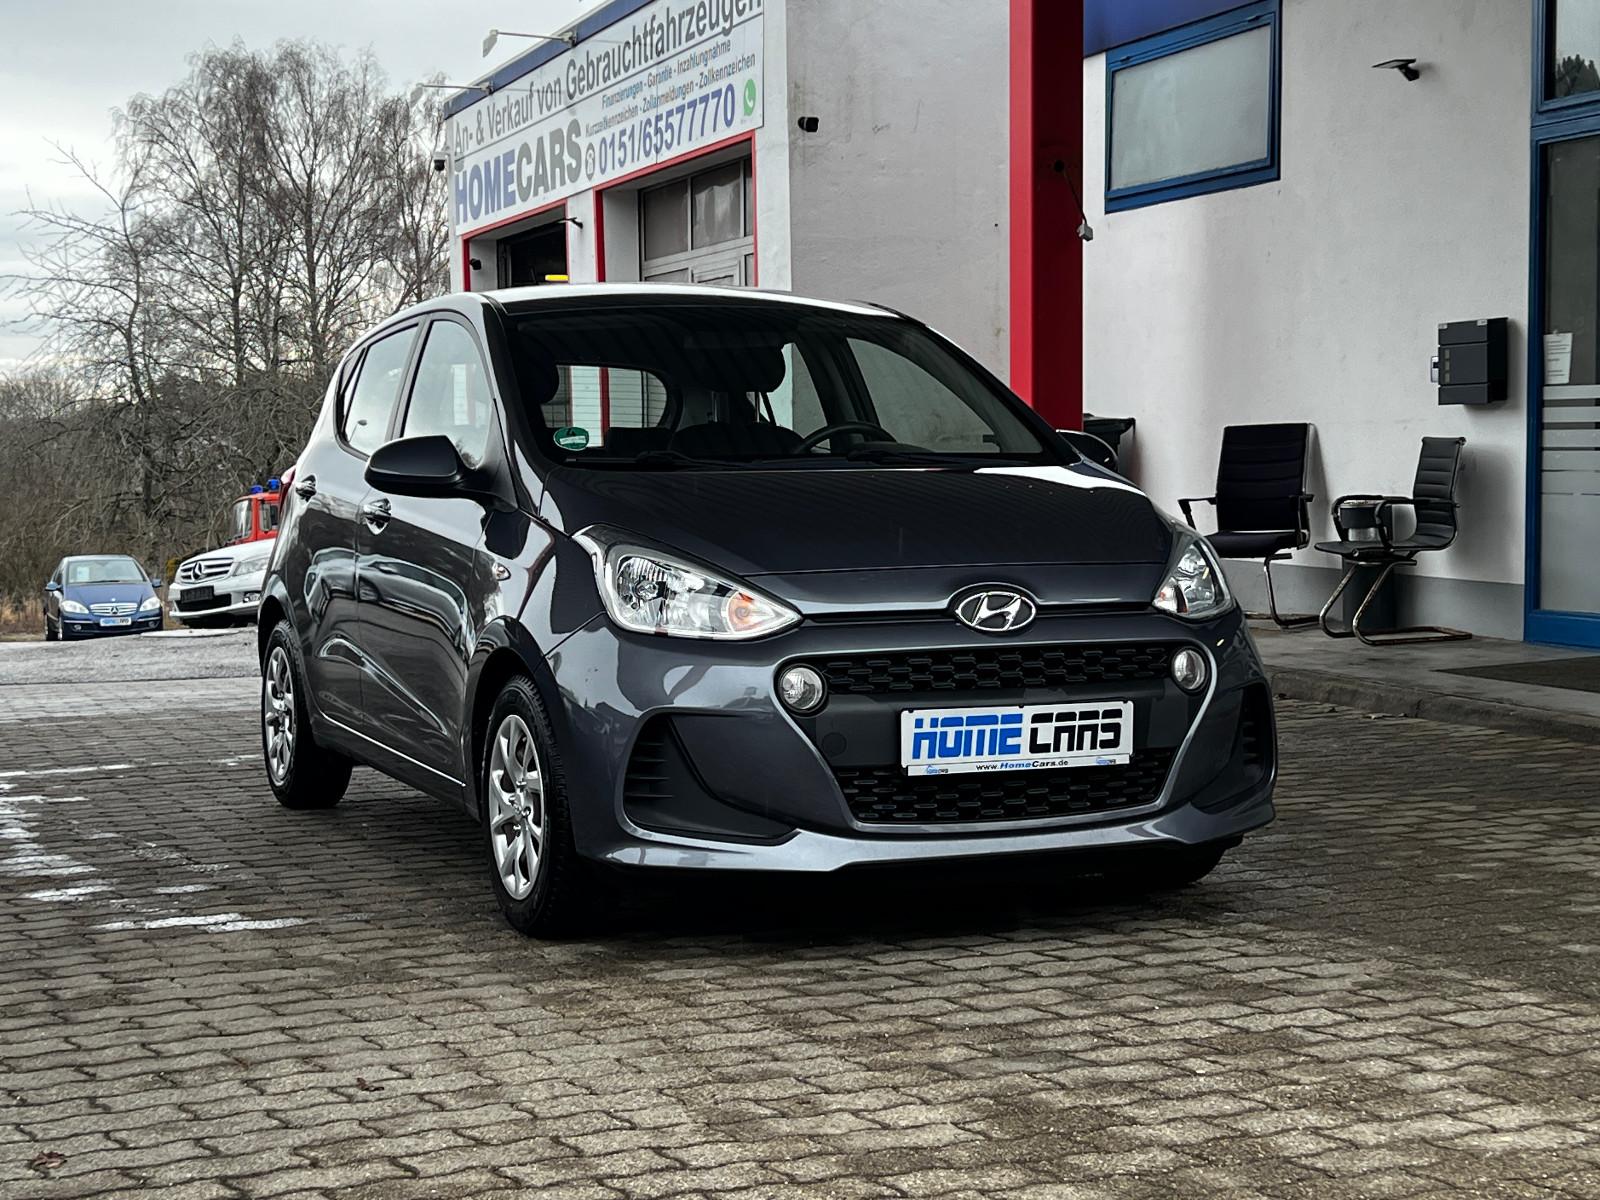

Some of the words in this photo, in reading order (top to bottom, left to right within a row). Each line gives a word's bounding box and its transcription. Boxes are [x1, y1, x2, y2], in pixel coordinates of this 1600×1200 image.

[475, 109, 485, 146] &
[487, 81, 534, 139] Verkauf
[537, 77, 562, 115] von
[566, 0, 762, 101] Gebrauchtfahrzeug
[647, 65, 673, 88] Garantie
[677, 40, 732, 75] Inzahlungnahme
[699, 53, 756, 89] Zollkennzeichen
[599, 83, 736, 175] 0151/65577770
[912, 713, 1023, 760] HOME
[1029, 708, 1123, 754] CARS
[975, 759, 1069, 772] www.HomeCars.de
